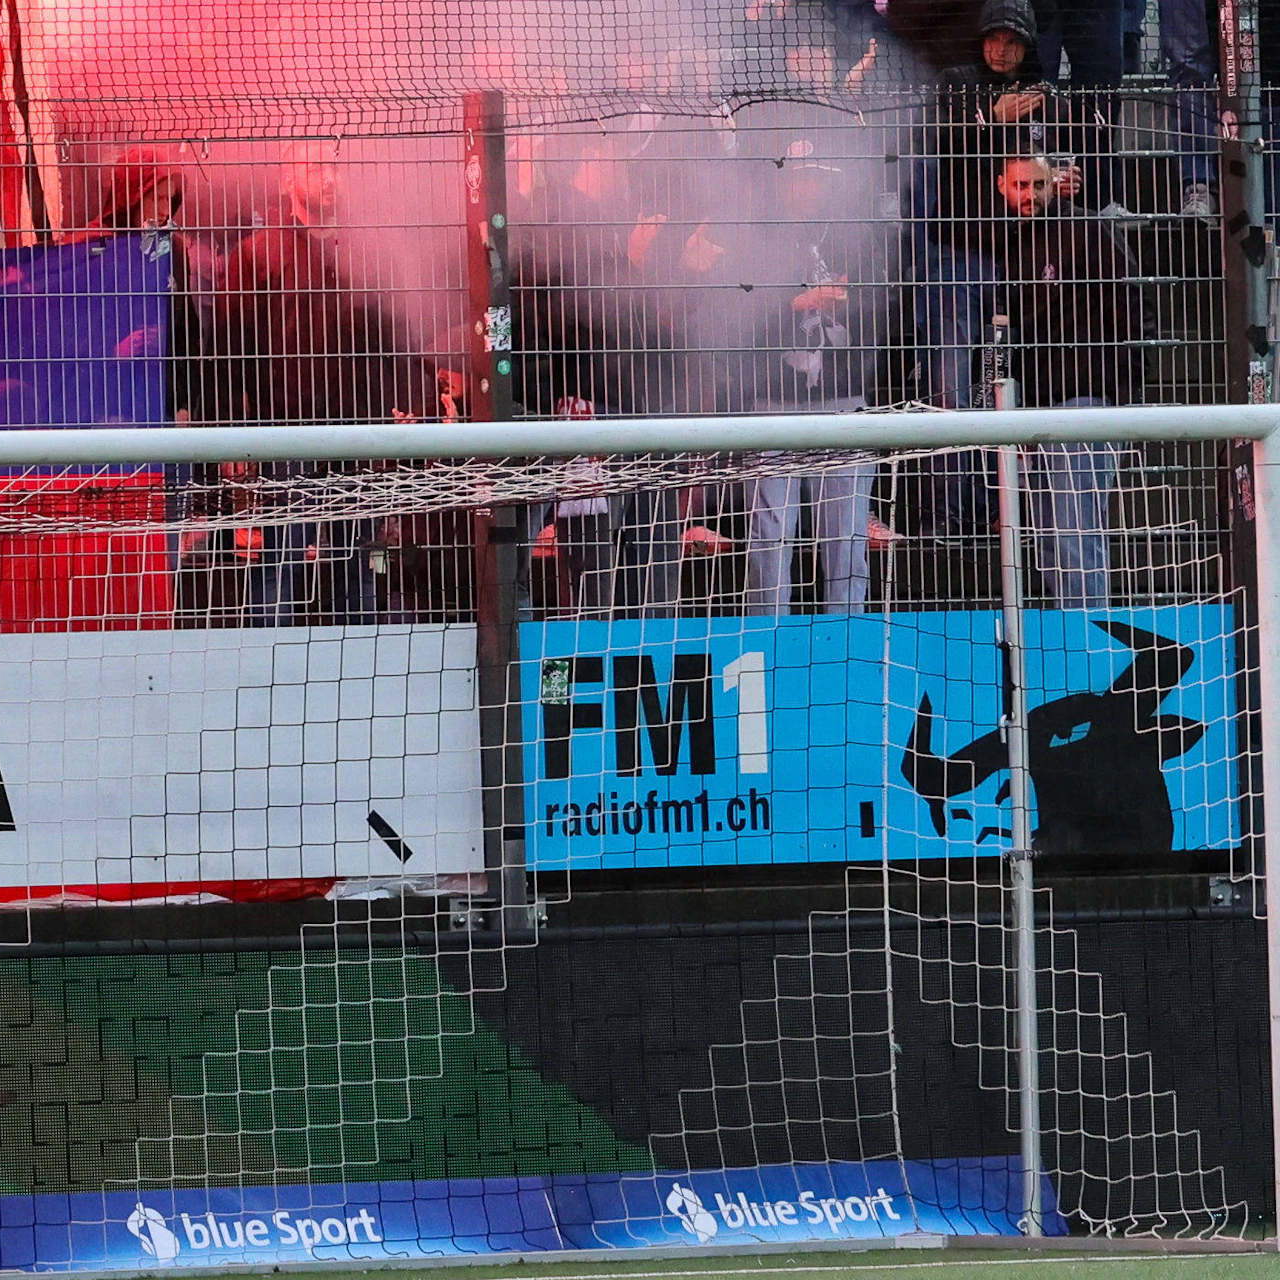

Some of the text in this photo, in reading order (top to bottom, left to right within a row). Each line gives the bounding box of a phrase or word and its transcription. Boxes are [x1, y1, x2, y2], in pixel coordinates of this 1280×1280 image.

[543, 651, 769, 780] FM1
[545, 788, 771, 839] radiofm1.ch
[180, 1208, 383, 1255] blue Sport
[714, 1187, 901, 1234] blue Sport
